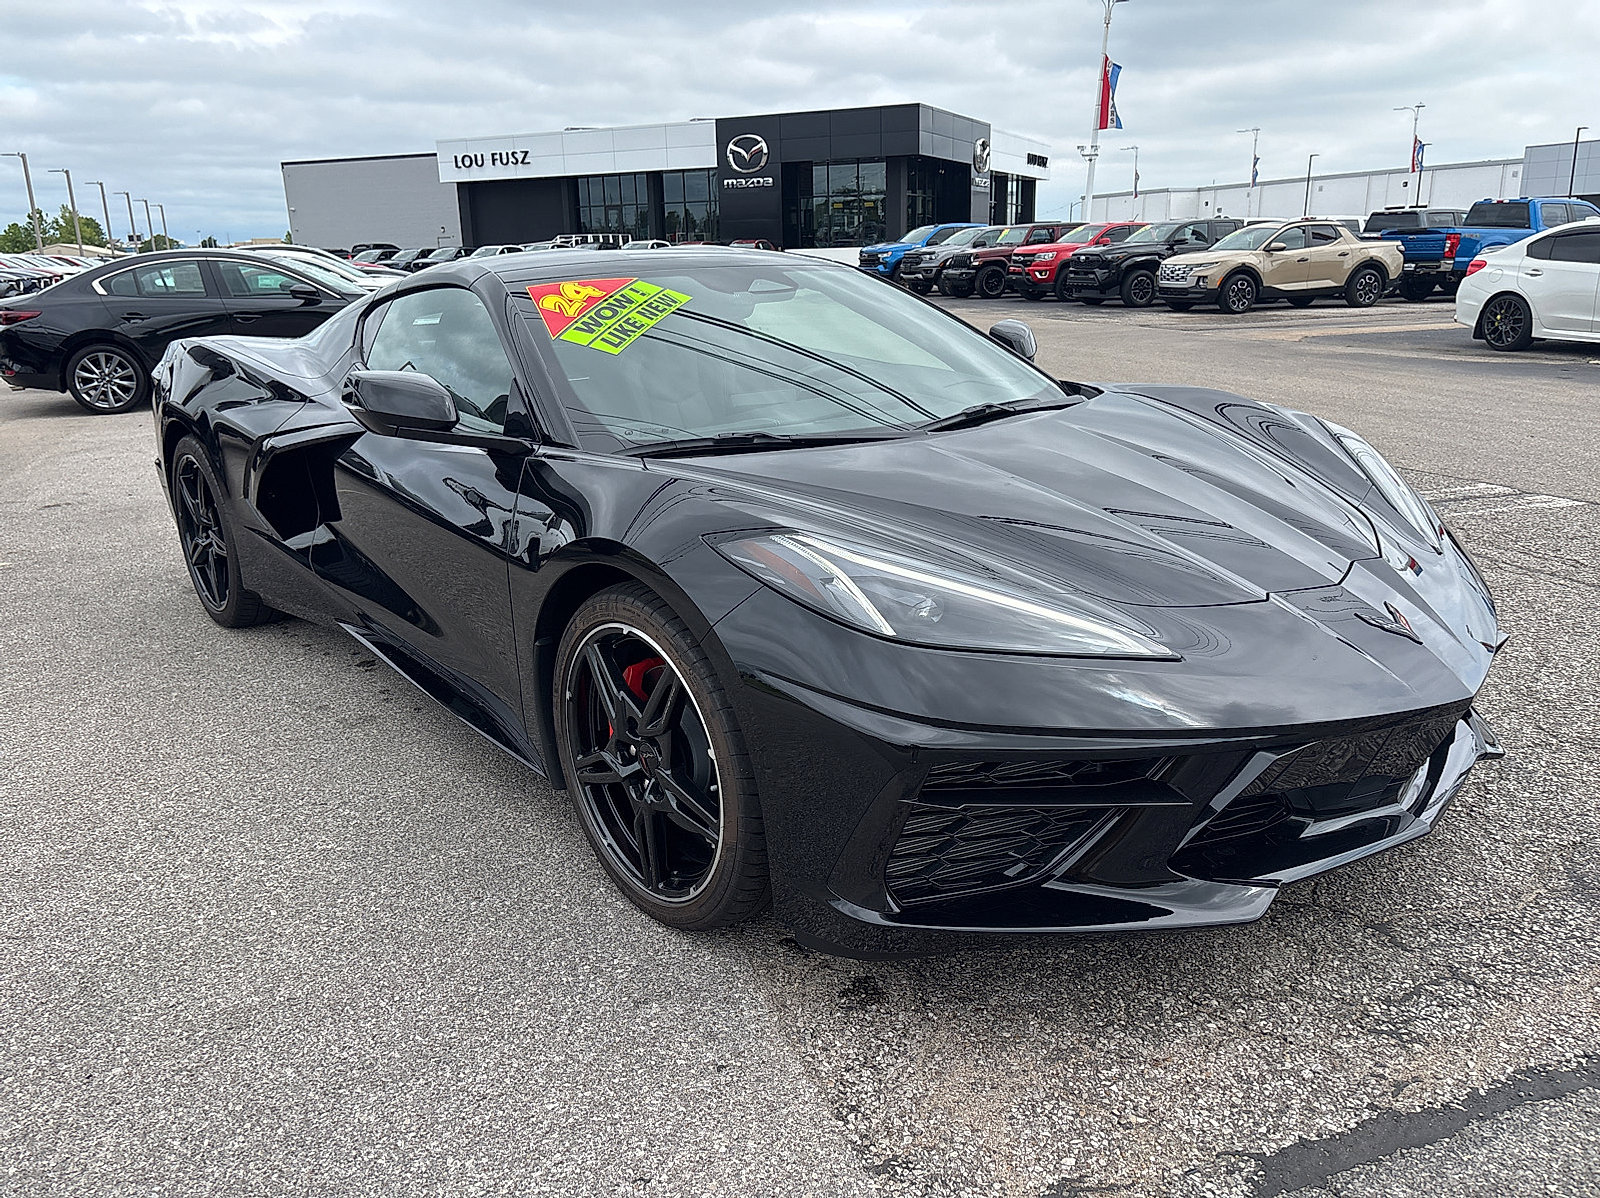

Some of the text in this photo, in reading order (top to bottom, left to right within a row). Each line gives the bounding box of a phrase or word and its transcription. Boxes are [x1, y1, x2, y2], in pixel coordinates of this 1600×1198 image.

[453, 150, 531, 169] LOU FUSZ
[538, 281, 607, 318] 24
[600, 293, 679, 349] LIKE NEW
